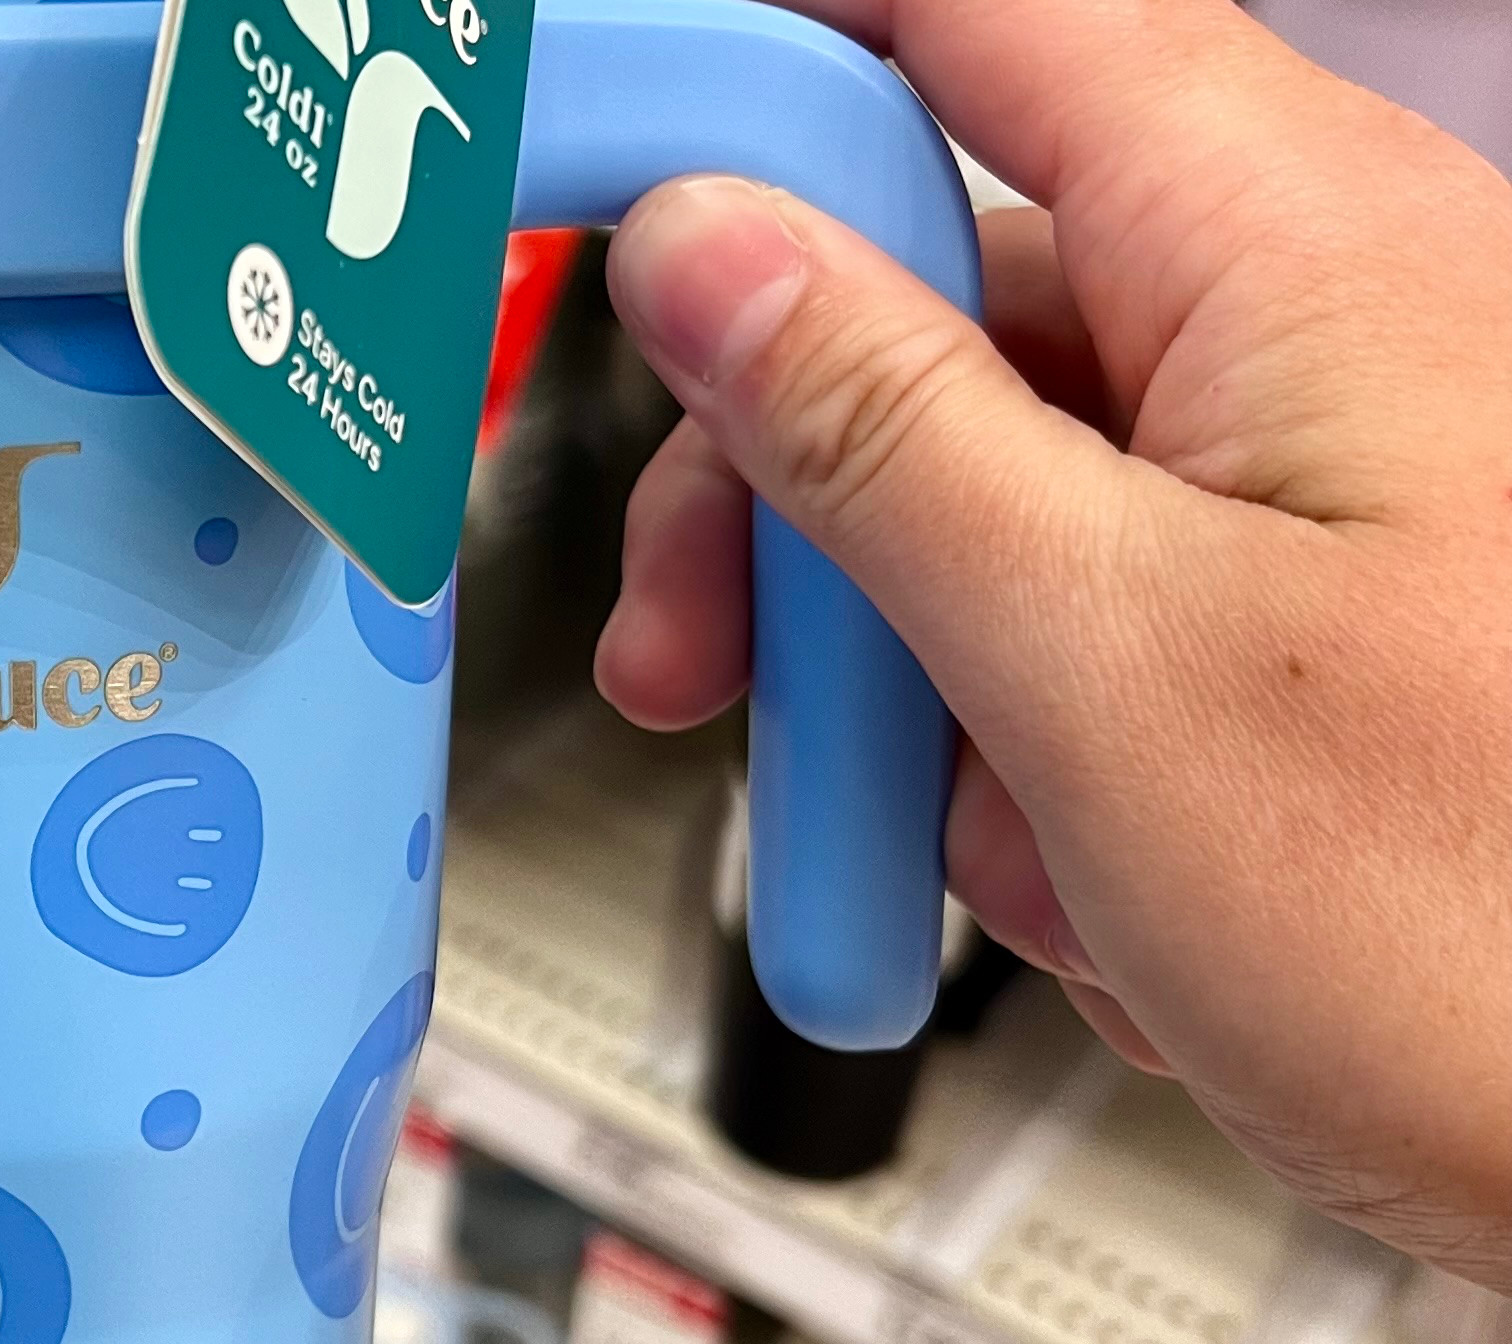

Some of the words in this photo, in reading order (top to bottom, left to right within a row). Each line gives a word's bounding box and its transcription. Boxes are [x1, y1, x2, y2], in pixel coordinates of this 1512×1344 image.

[243, 85, 281, 146] 24
[285, 138, 319, 188] oz
[287, 353, 320, 405] 24
[320, 384, 382, 473] Hours
[297, 308, 357, 393] Stays
[358, 373, 406, 444] Cold
